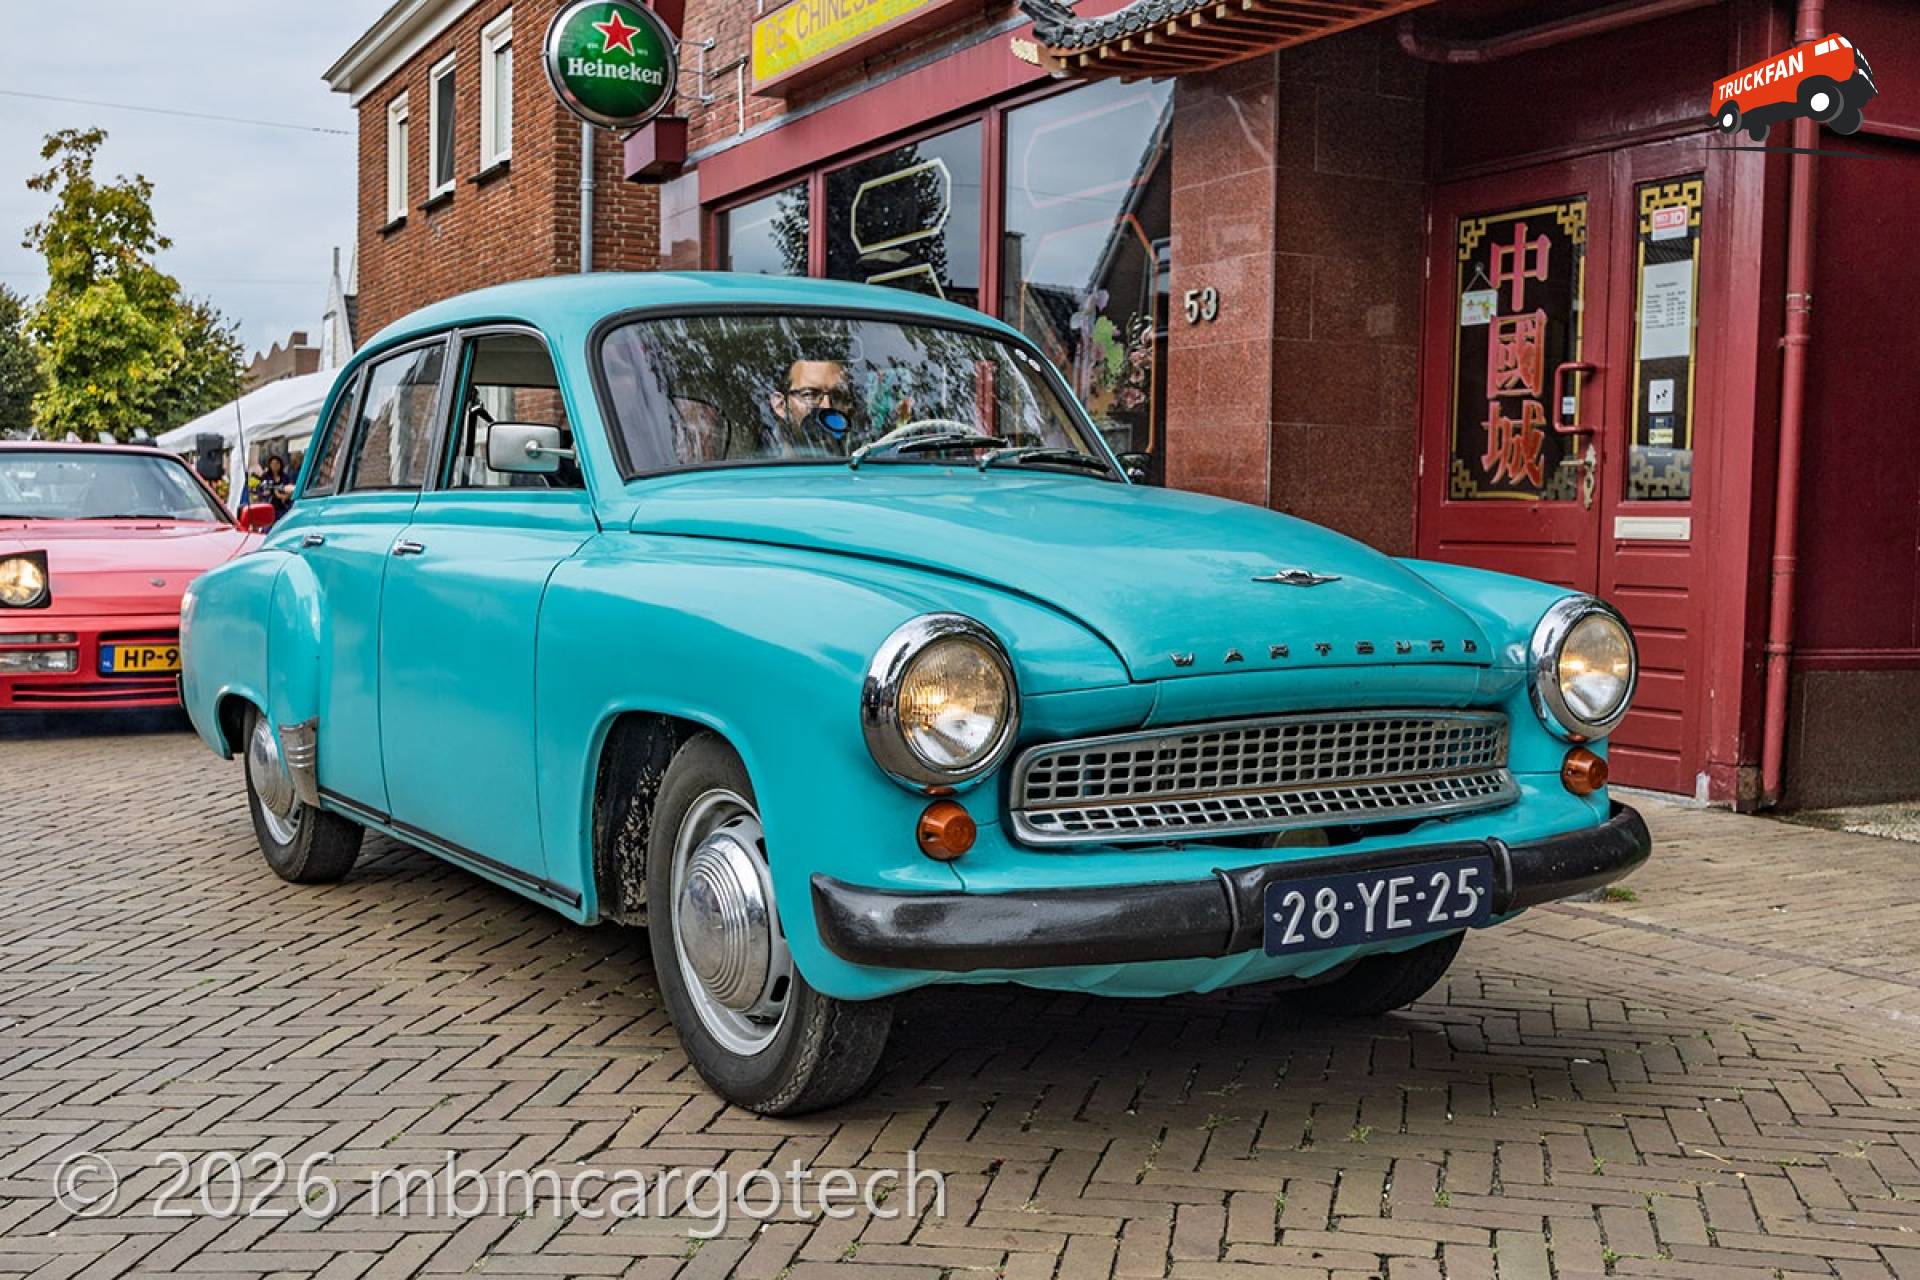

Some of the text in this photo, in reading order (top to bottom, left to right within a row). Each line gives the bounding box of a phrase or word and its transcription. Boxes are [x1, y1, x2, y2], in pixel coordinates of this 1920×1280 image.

[796, 0, 878, 39] CHIN
[567, 57, 663, 85] Heineken
[1184, 287, 1217, 324] 53
[1481, 222, 1552, 487] 中國城
[1170, 639, 1478, 666] WARTBURG
